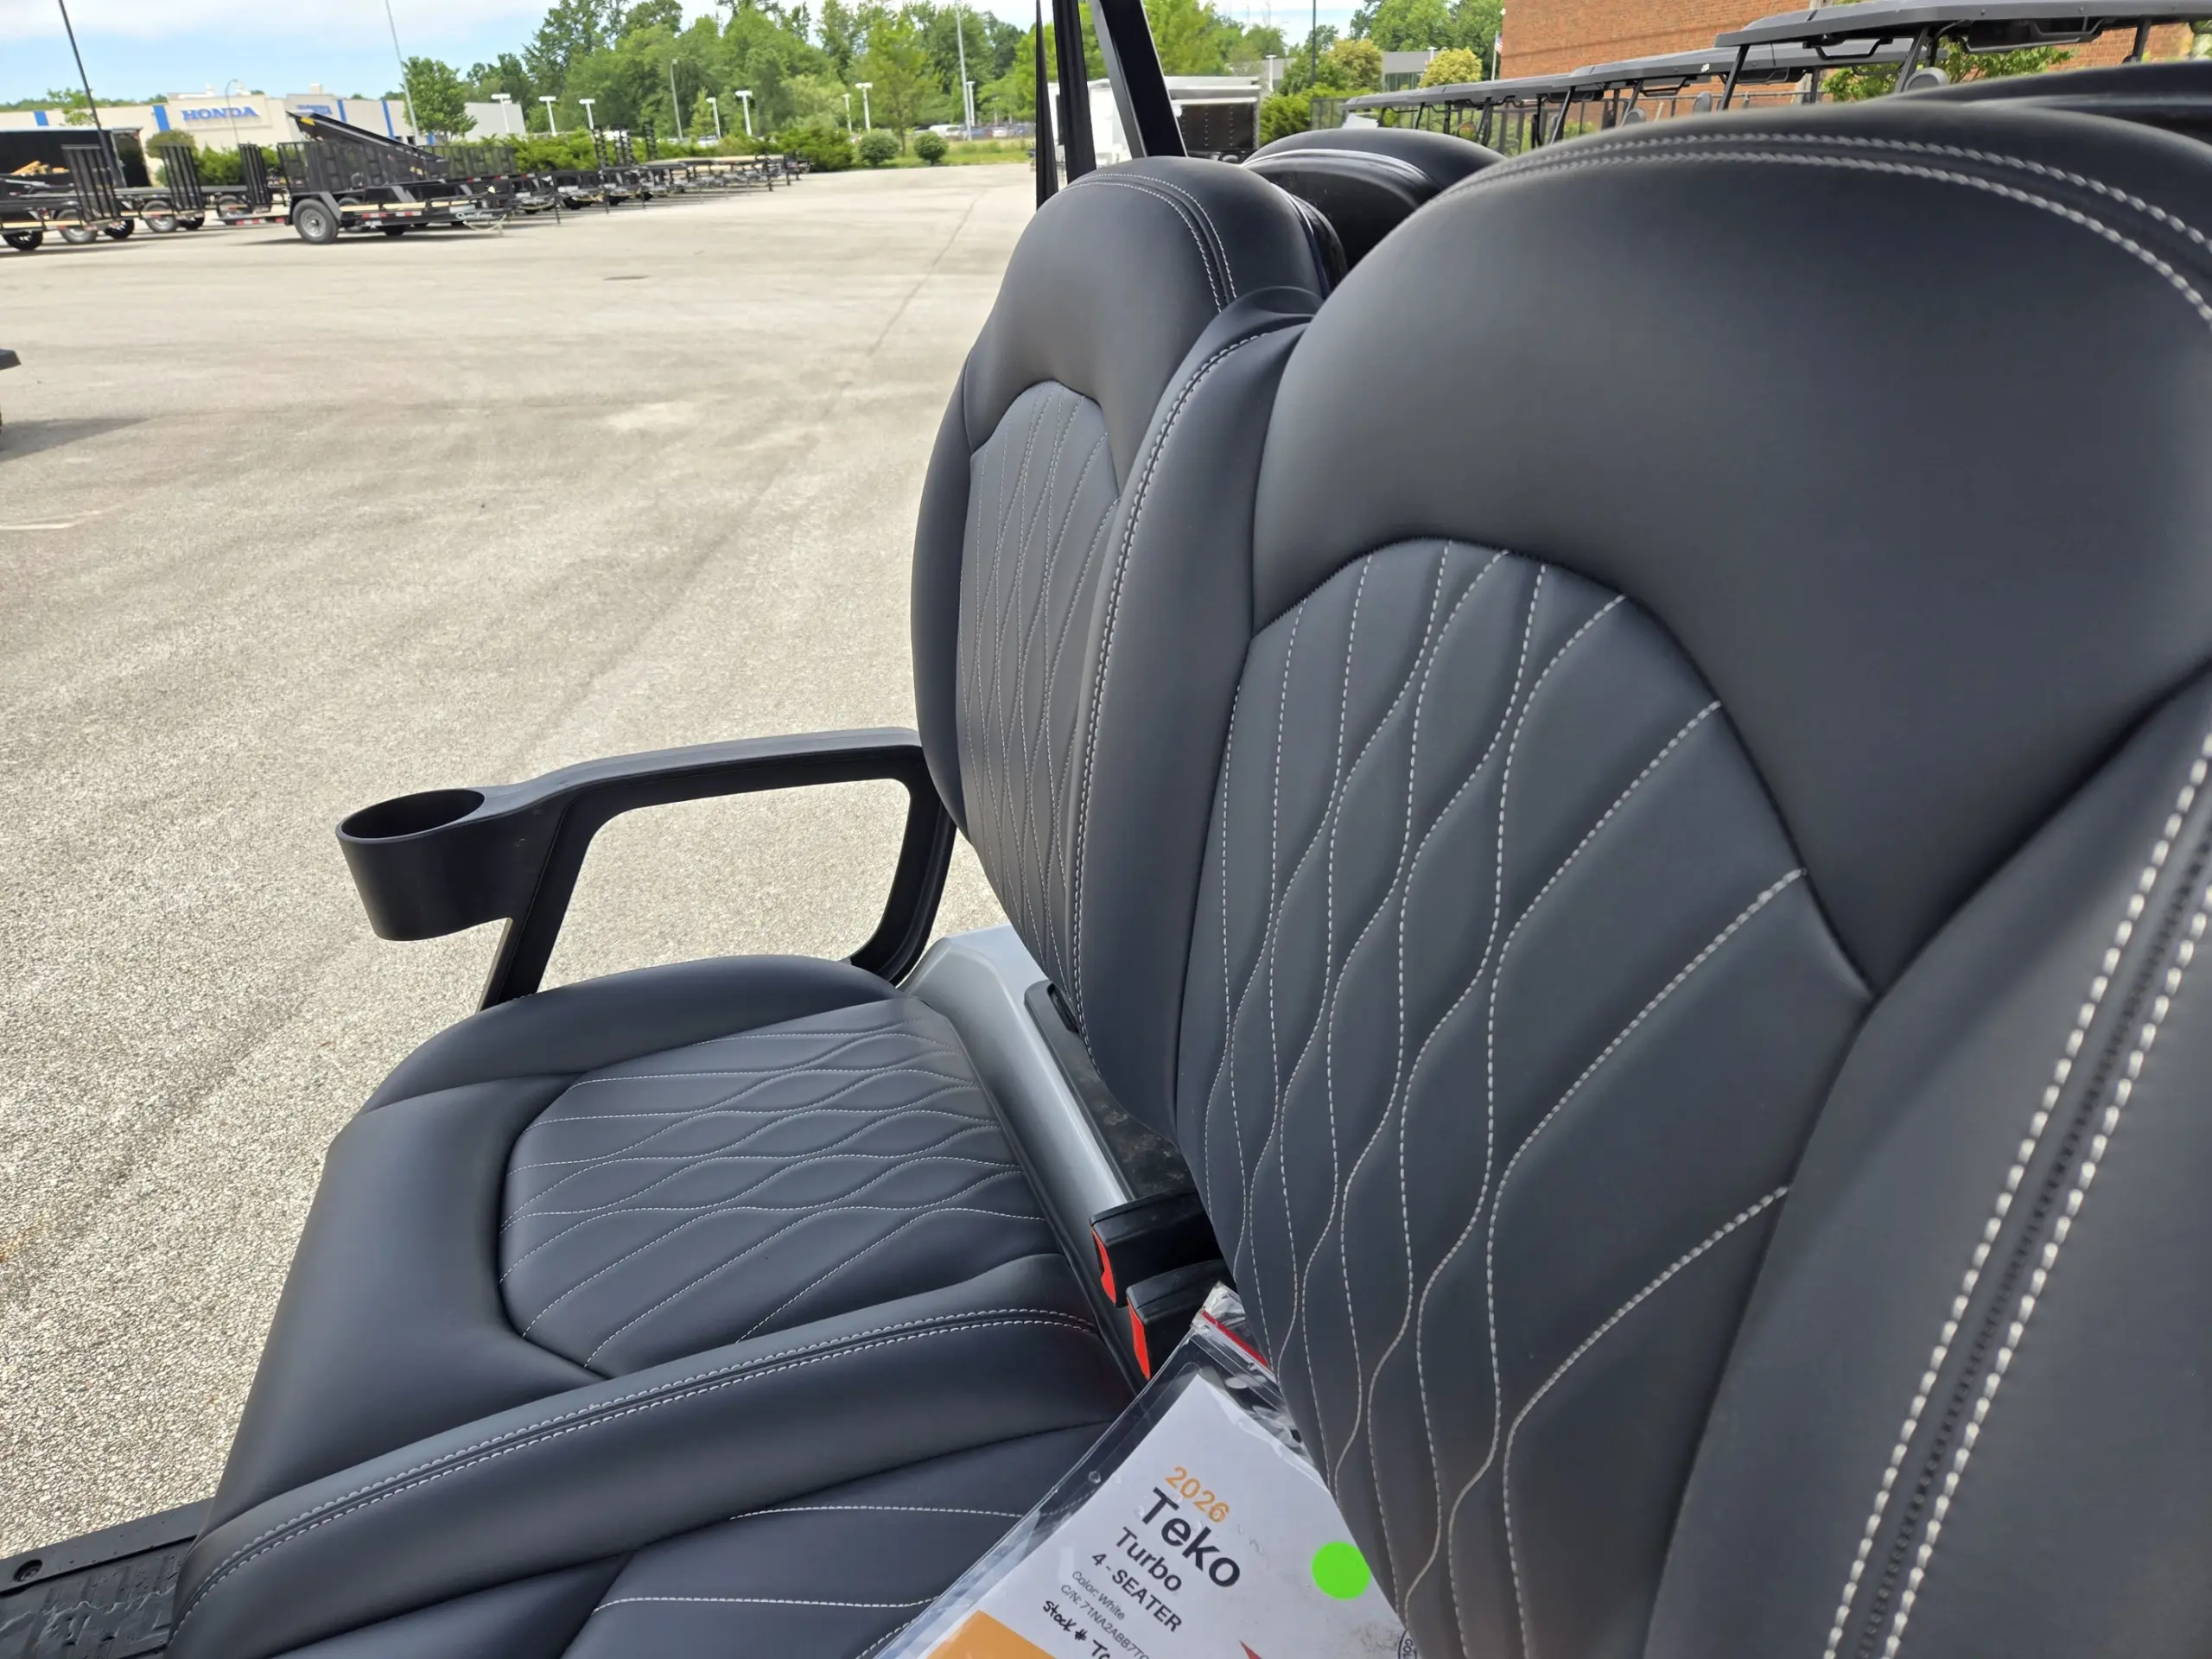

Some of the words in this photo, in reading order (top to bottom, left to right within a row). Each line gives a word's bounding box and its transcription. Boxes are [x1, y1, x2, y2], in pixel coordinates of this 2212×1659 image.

[180, 106, 259, 121] HONDA
[1165, 1466, 1230, 1522] 2026
[1116, 1526, 1182, 1592] Turbo
[1141, 1486, 1241, 1588] Teko
[1060, 1584, 1082, 1605] C/N:
[1071, 1570, 1098, 1598] Color:
[1097, 1593, 1126, 1620] White
[1111, 1569, 1183, 1633] SEATER
[1074, 1628, 1088, 1641] #
